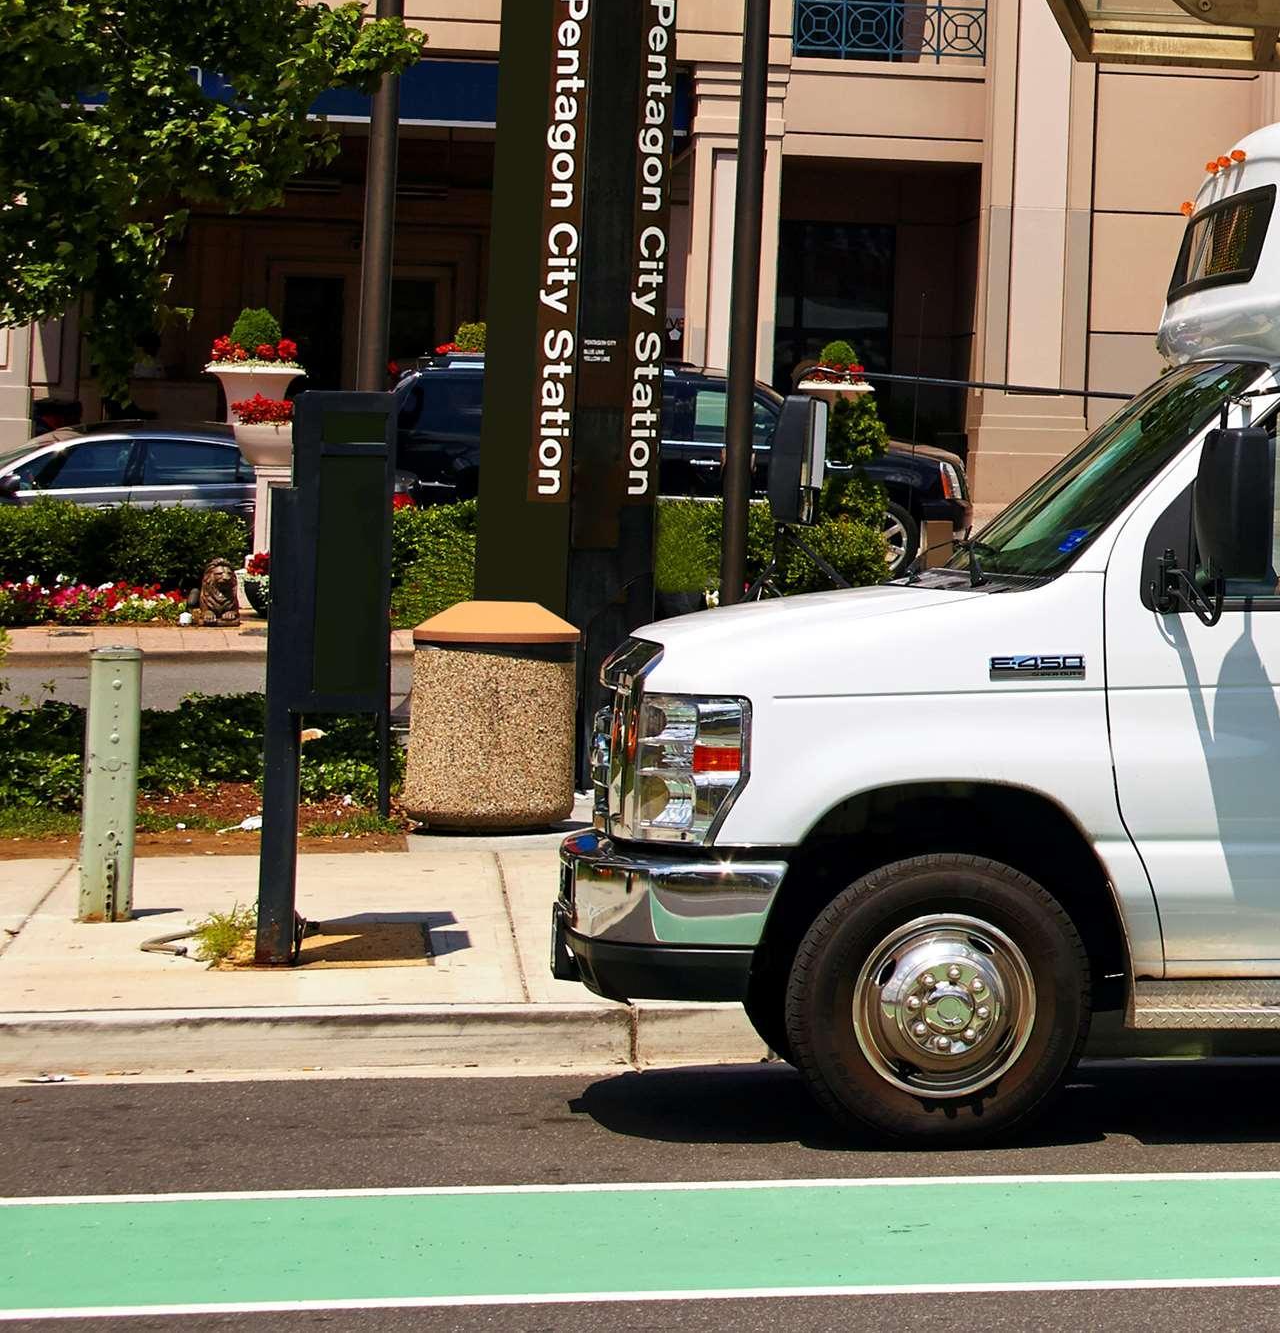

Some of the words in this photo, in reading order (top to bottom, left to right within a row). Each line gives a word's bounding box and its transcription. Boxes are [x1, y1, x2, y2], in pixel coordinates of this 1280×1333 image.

[540, 222, 578, 314] City
[631, 226, 666, 316] City
[537, 329, 574, 495] Station
[627, 331, 661, 495] Station
[990, 656, 1085, 670] E-450
